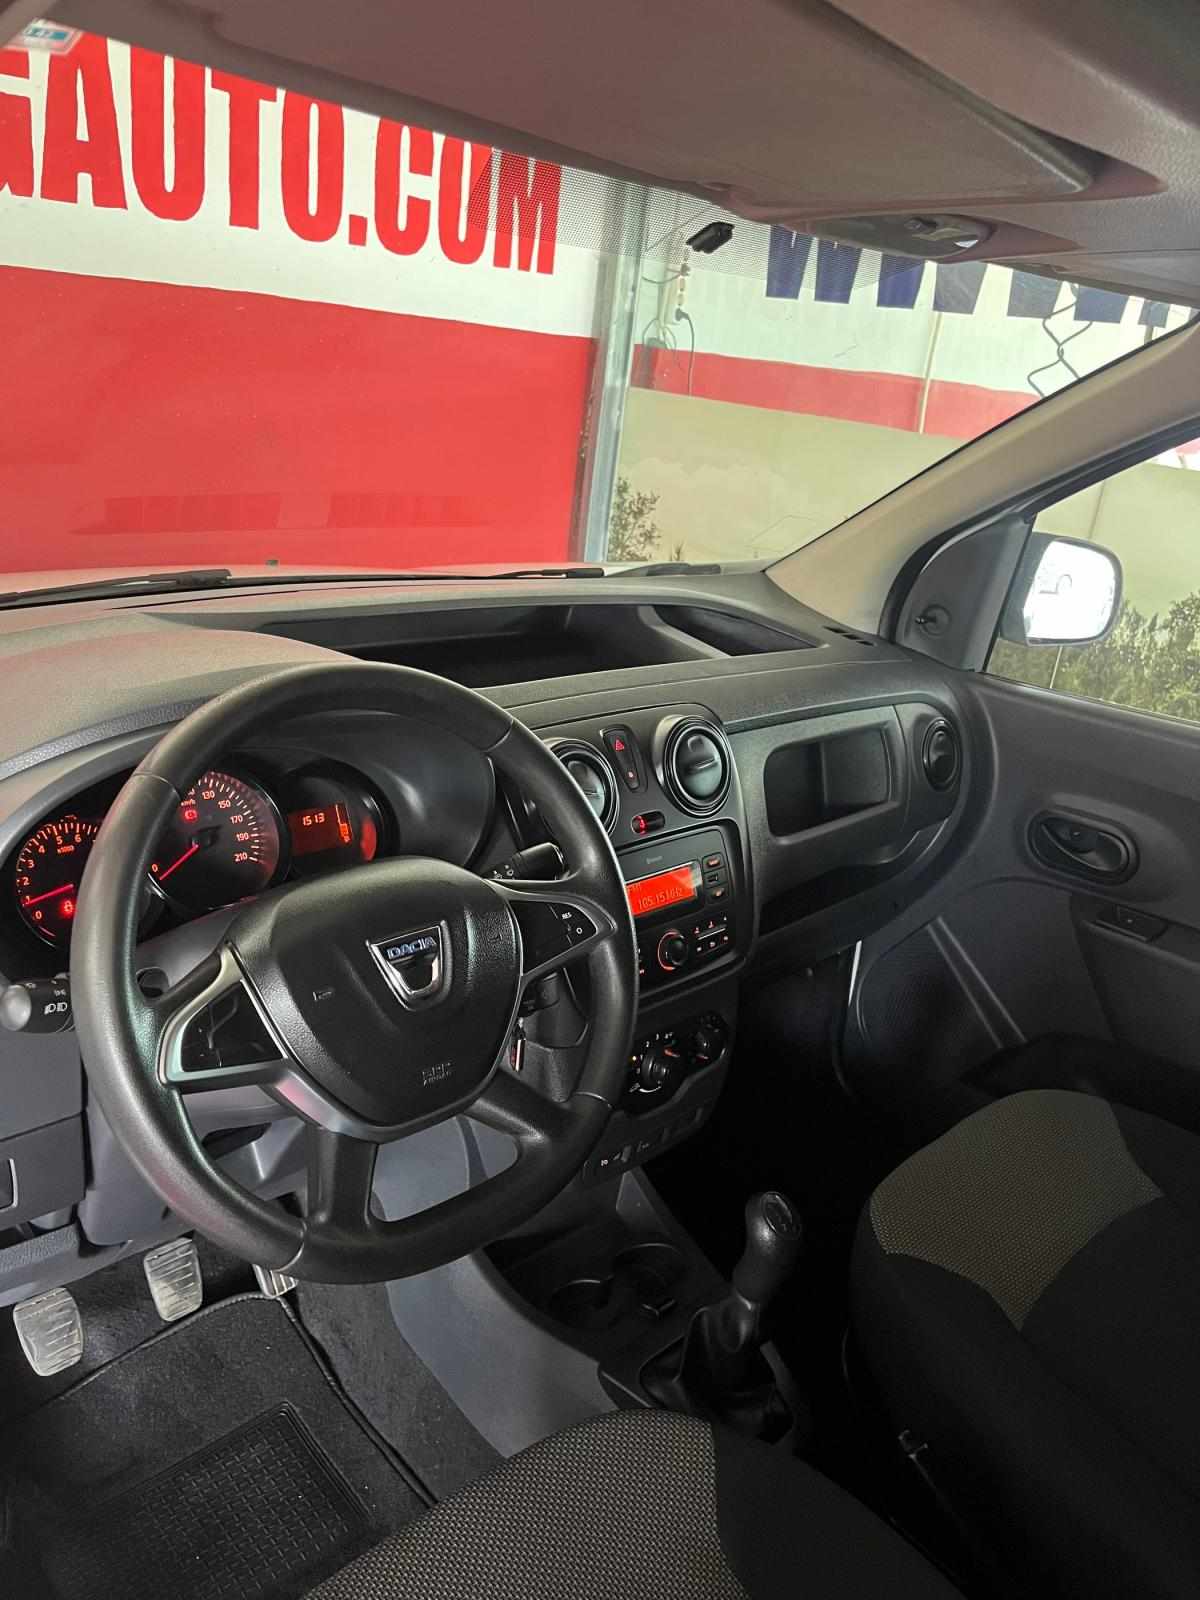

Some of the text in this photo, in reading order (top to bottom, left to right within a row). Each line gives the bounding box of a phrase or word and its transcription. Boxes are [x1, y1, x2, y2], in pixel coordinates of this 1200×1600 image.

[202, 790, 215, 800] 130
[218, 800, 231, 809] 150
[230, 815, 243, 824] 170
[56, 836, 63, 845] 5
[74, 834, 81, 843] 6
[236, 832, 249, 841] 190
[38, 845, 45, 854] 4
[234, 852, 248, 862] 210
[27, 860, 34, 868] 3
[151, 864, 158, 872] 0
[22, 877, 29, 886] 2
[35, 911, 42, 919] 0
[386, 936, 437, 960] DACIA
